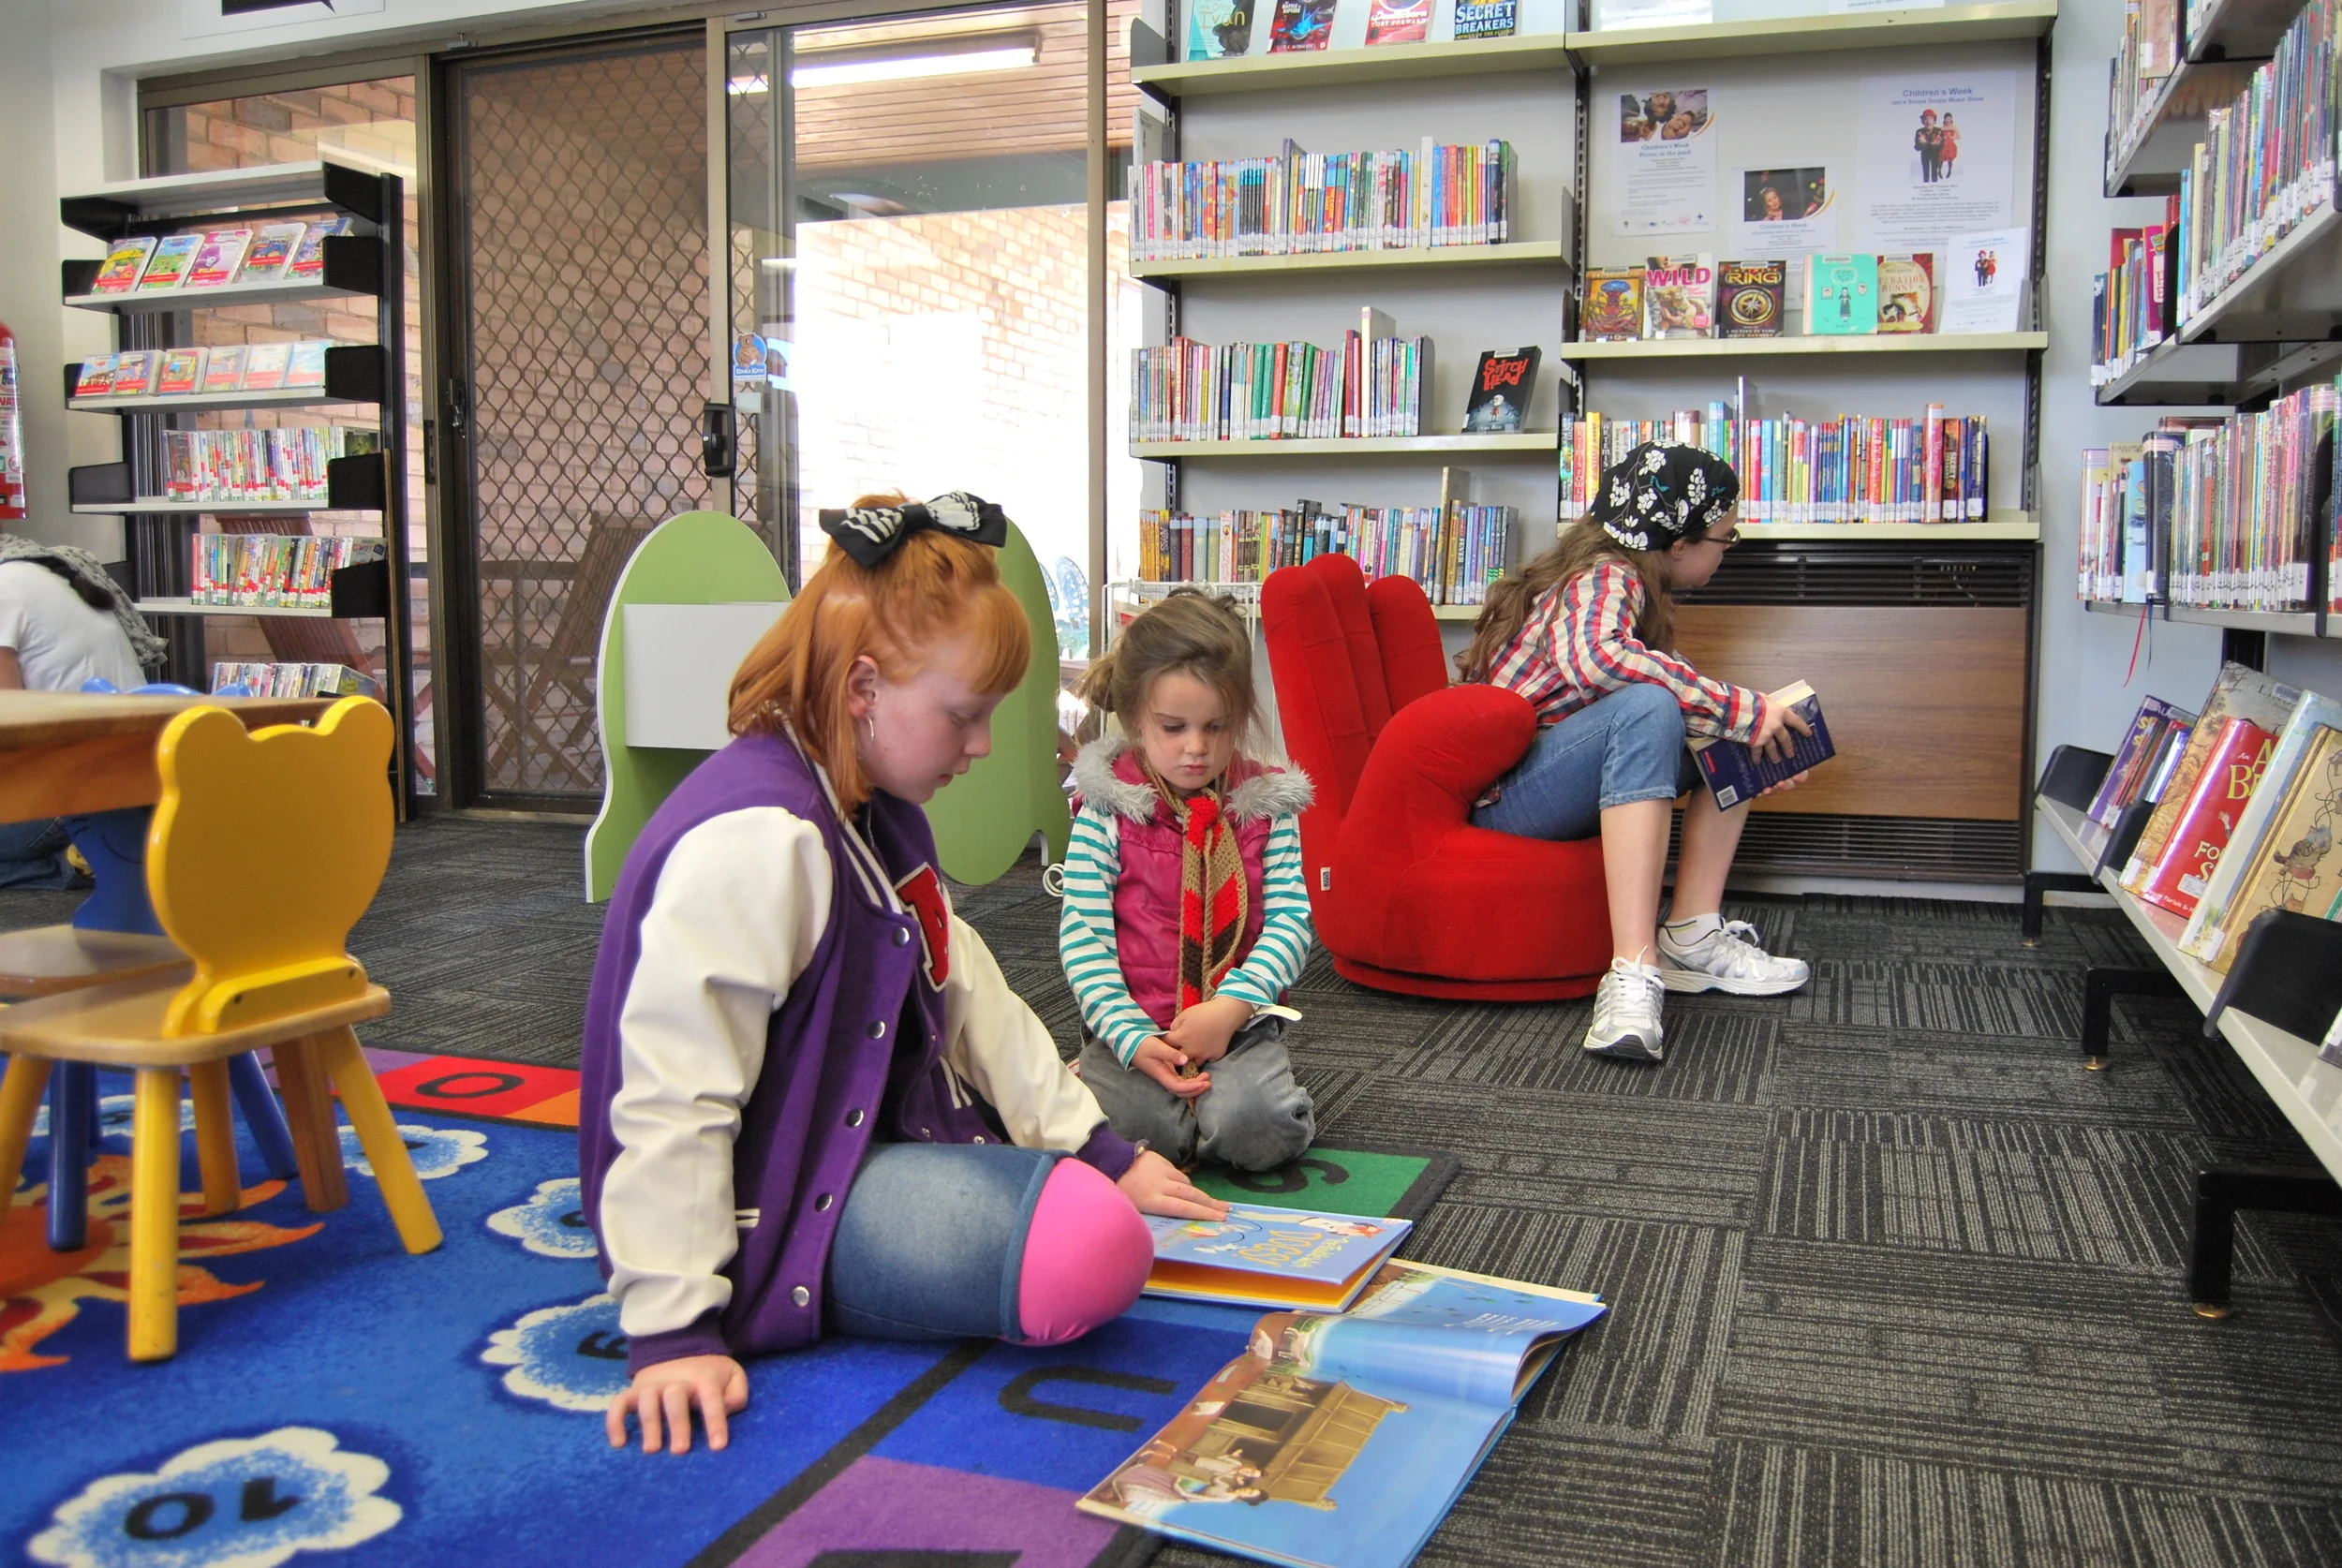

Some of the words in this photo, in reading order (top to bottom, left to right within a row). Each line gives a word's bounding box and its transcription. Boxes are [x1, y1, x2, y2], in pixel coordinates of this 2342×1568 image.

[1199, 9, 1246, 30] Ivan
[1456, 2, 1516, 23] SECRET
[1391, 18, 1428, 26] FORWARD
[1455, 18, 1515, 35] BREAKERS
[1903, 88, 1947, 98] Children's
[1949, 86, 1973, 96] Week
[1646, 268, 1711, 287] WILD
[1727, 272, 1779, 285] RING
